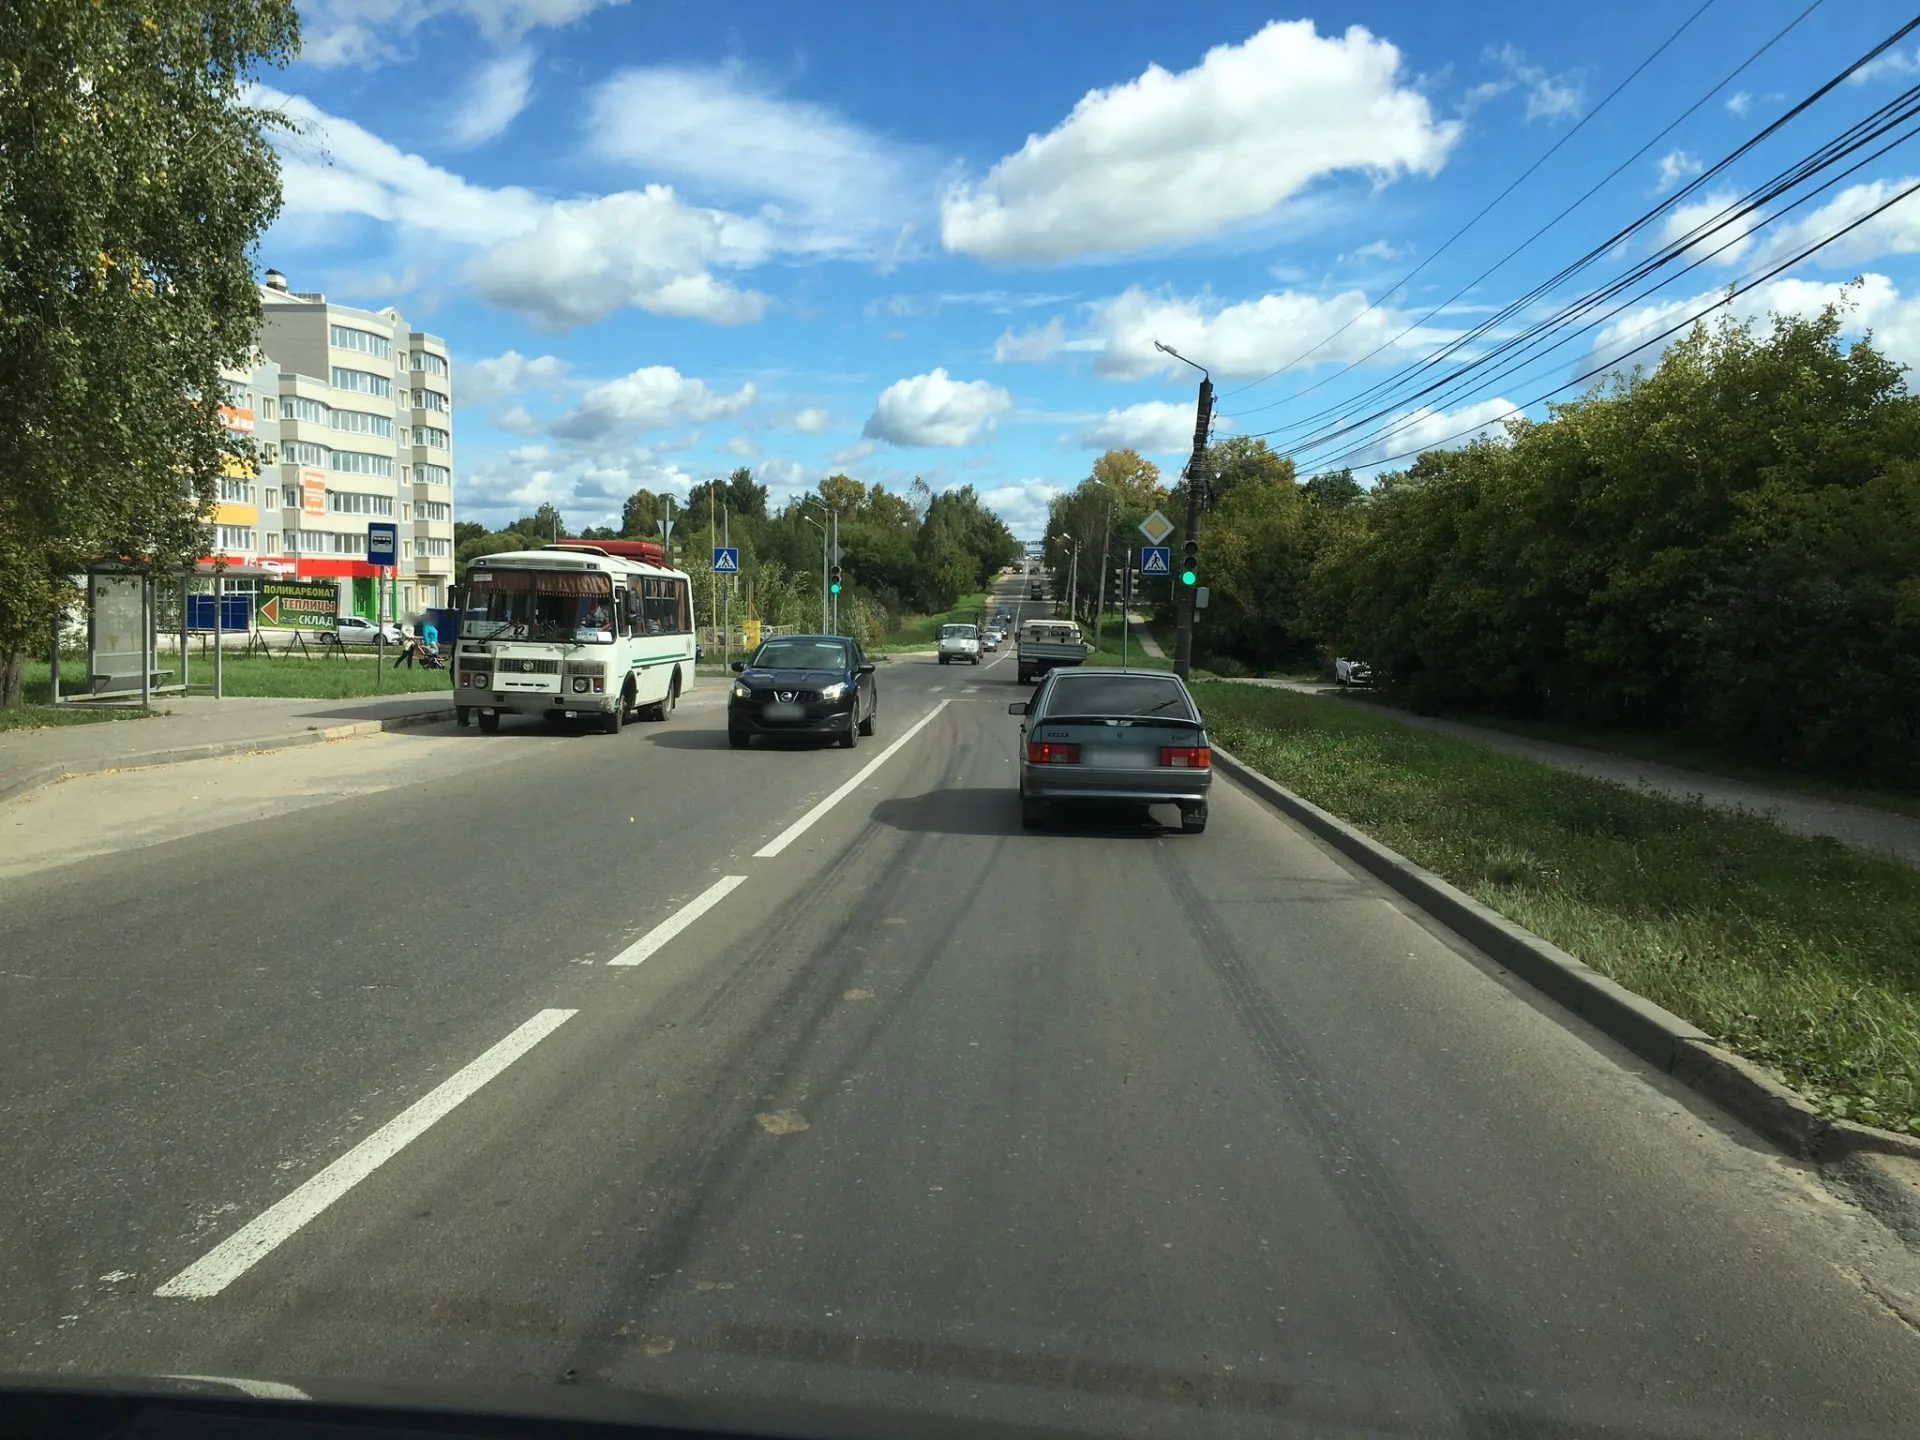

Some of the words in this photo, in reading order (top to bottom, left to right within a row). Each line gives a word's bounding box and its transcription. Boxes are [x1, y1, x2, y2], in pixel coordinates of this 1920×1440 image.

[264, 585, 335, 597] ПОЛИКАРБОНАТ
[282, 598, 336, 614] ТЕПЛИЦЫ
[298, 614, 334, 628] СКЛАД
[466, 622, 472, 636] 4
[513, 624, 525, 636] 12
